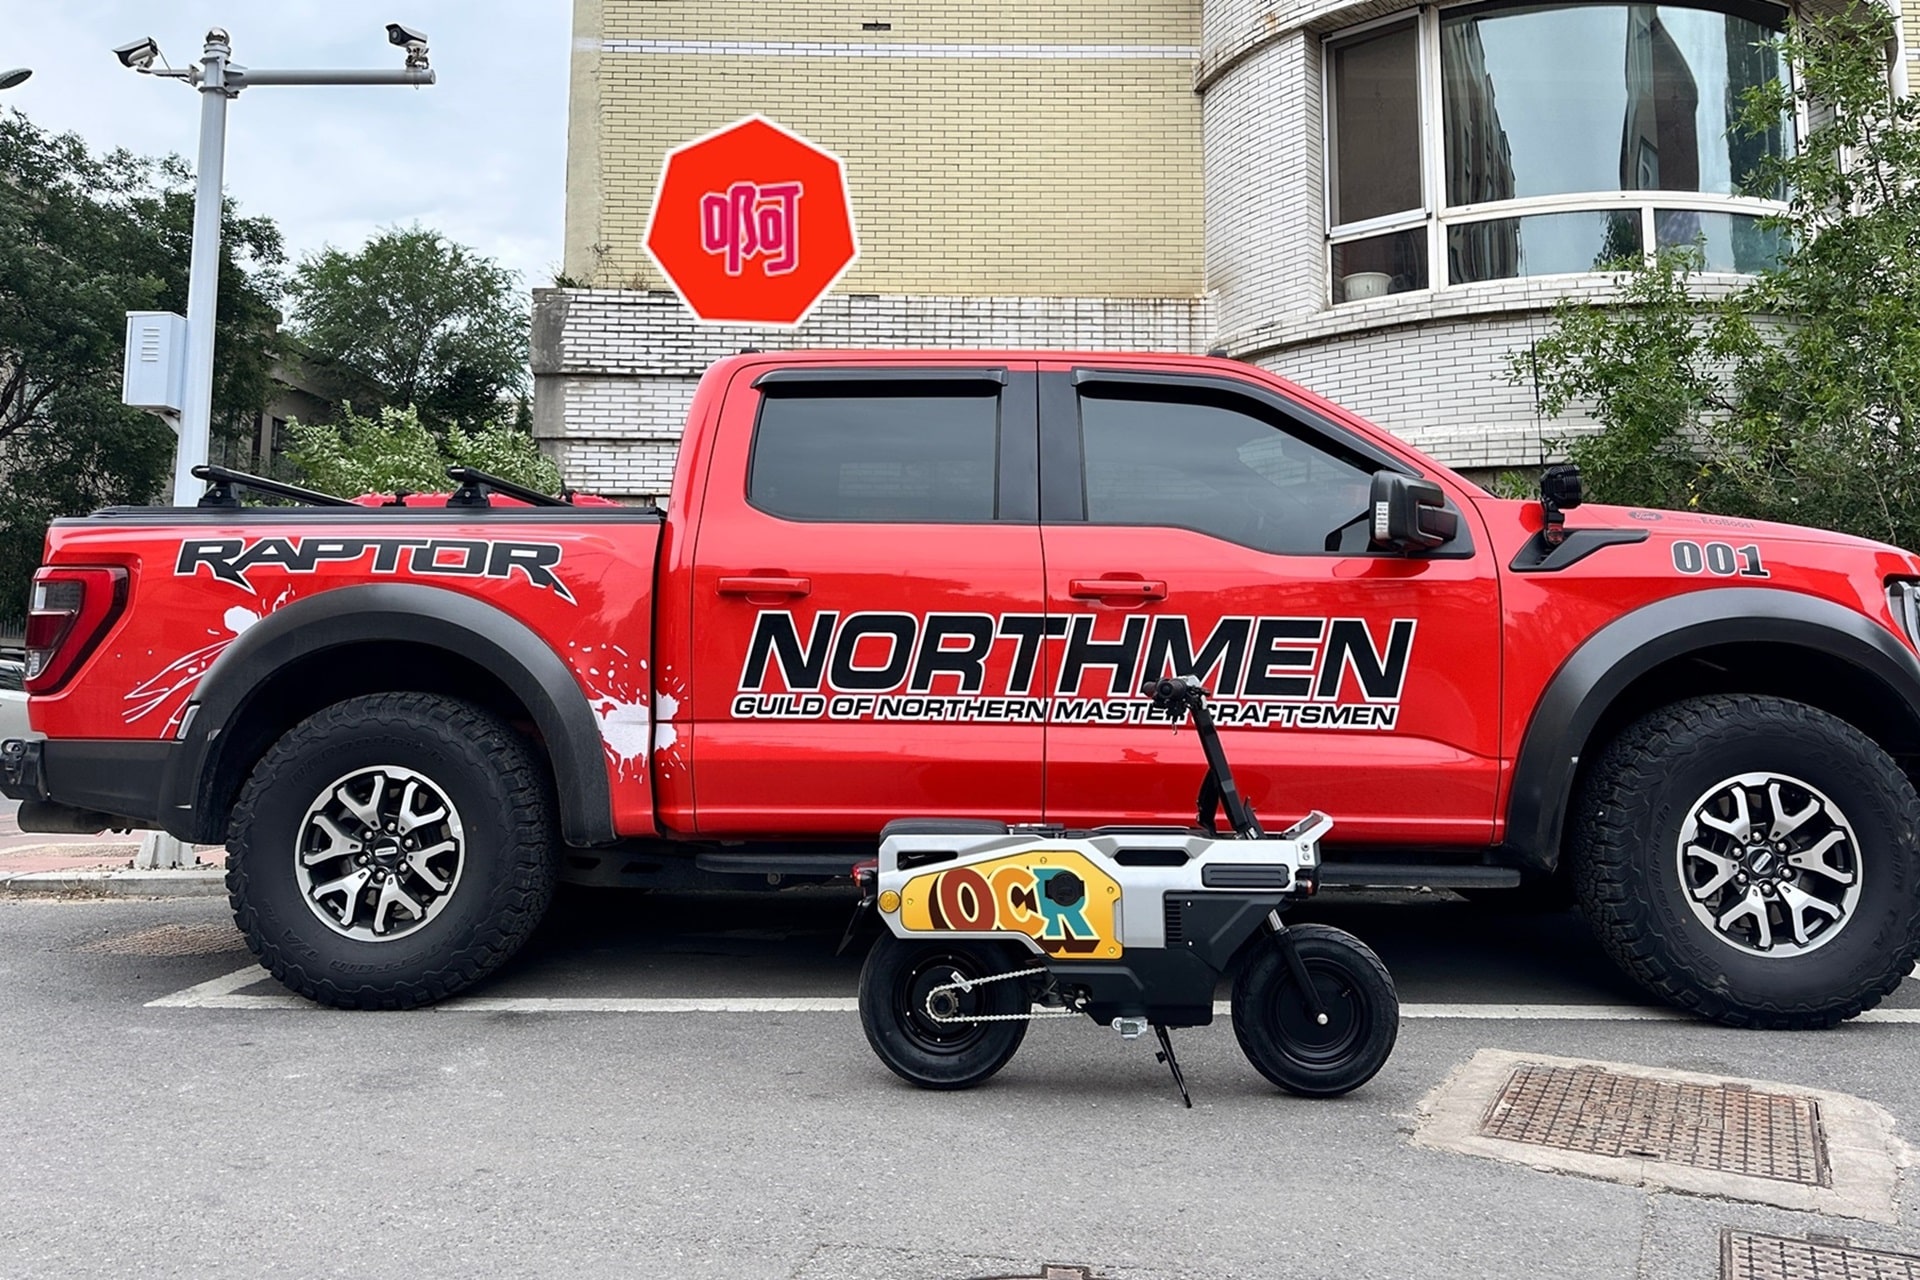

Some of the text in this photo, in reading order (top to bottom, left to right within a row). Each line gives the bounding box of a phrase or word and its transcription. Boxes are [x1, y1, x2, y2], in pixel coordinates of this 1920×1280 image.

[701, 182, 803, 277] 啊
[174, 536, 578, 606] RAPTOR
[1671, 540, 1771, 579] 001
[738, 610, 1417, 701] NORTHMEN
[732, 695, 826, 719] GUILD
[829, 695, 874, 719] OF
[876, 696, 1049, 722] NORTHERN
[930, 865, 1100, 951] OCR
